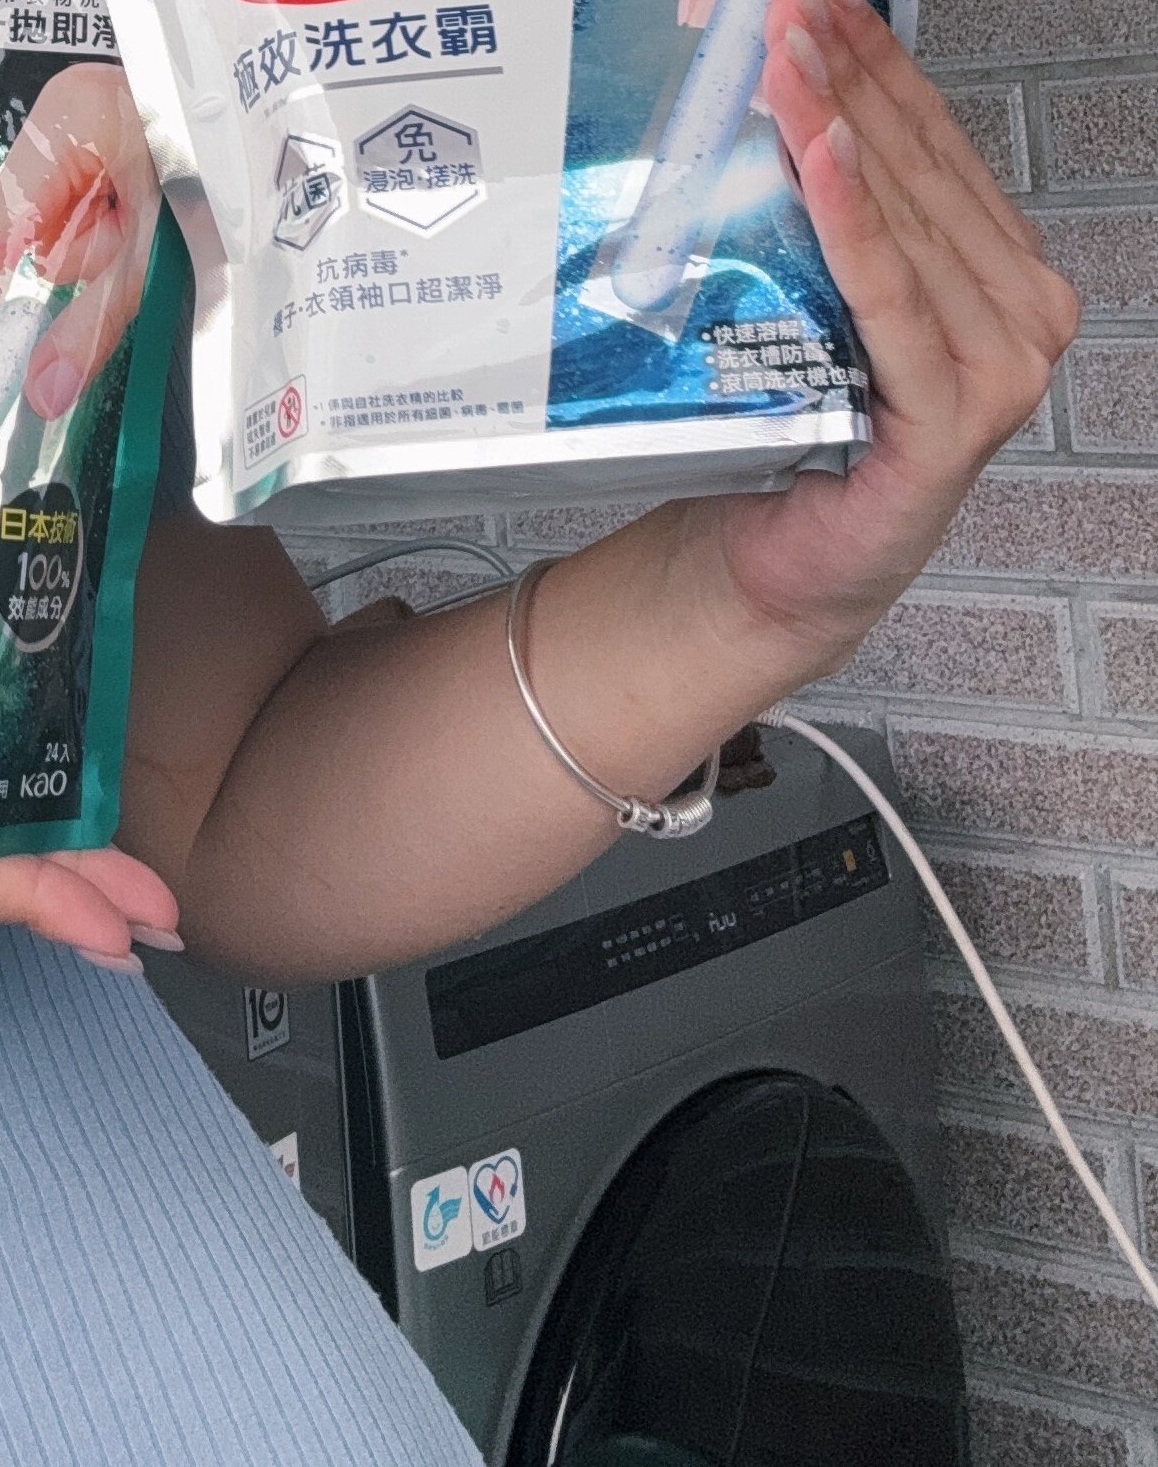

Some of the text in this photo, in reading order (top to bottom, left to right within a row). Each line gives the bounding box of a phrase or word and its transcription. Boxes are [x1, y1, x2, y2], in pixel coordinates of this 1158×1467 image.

[233, 4, 498, 113] 極效洗衣霸
[395, 123, 436, 164] 免
[713, 320, 802, 345] 快速溶解
[0, 508, 78, 544] 日本技術
[17, 551, 70, 592] 100%
[8, 594, 62, 621] 效能成分
